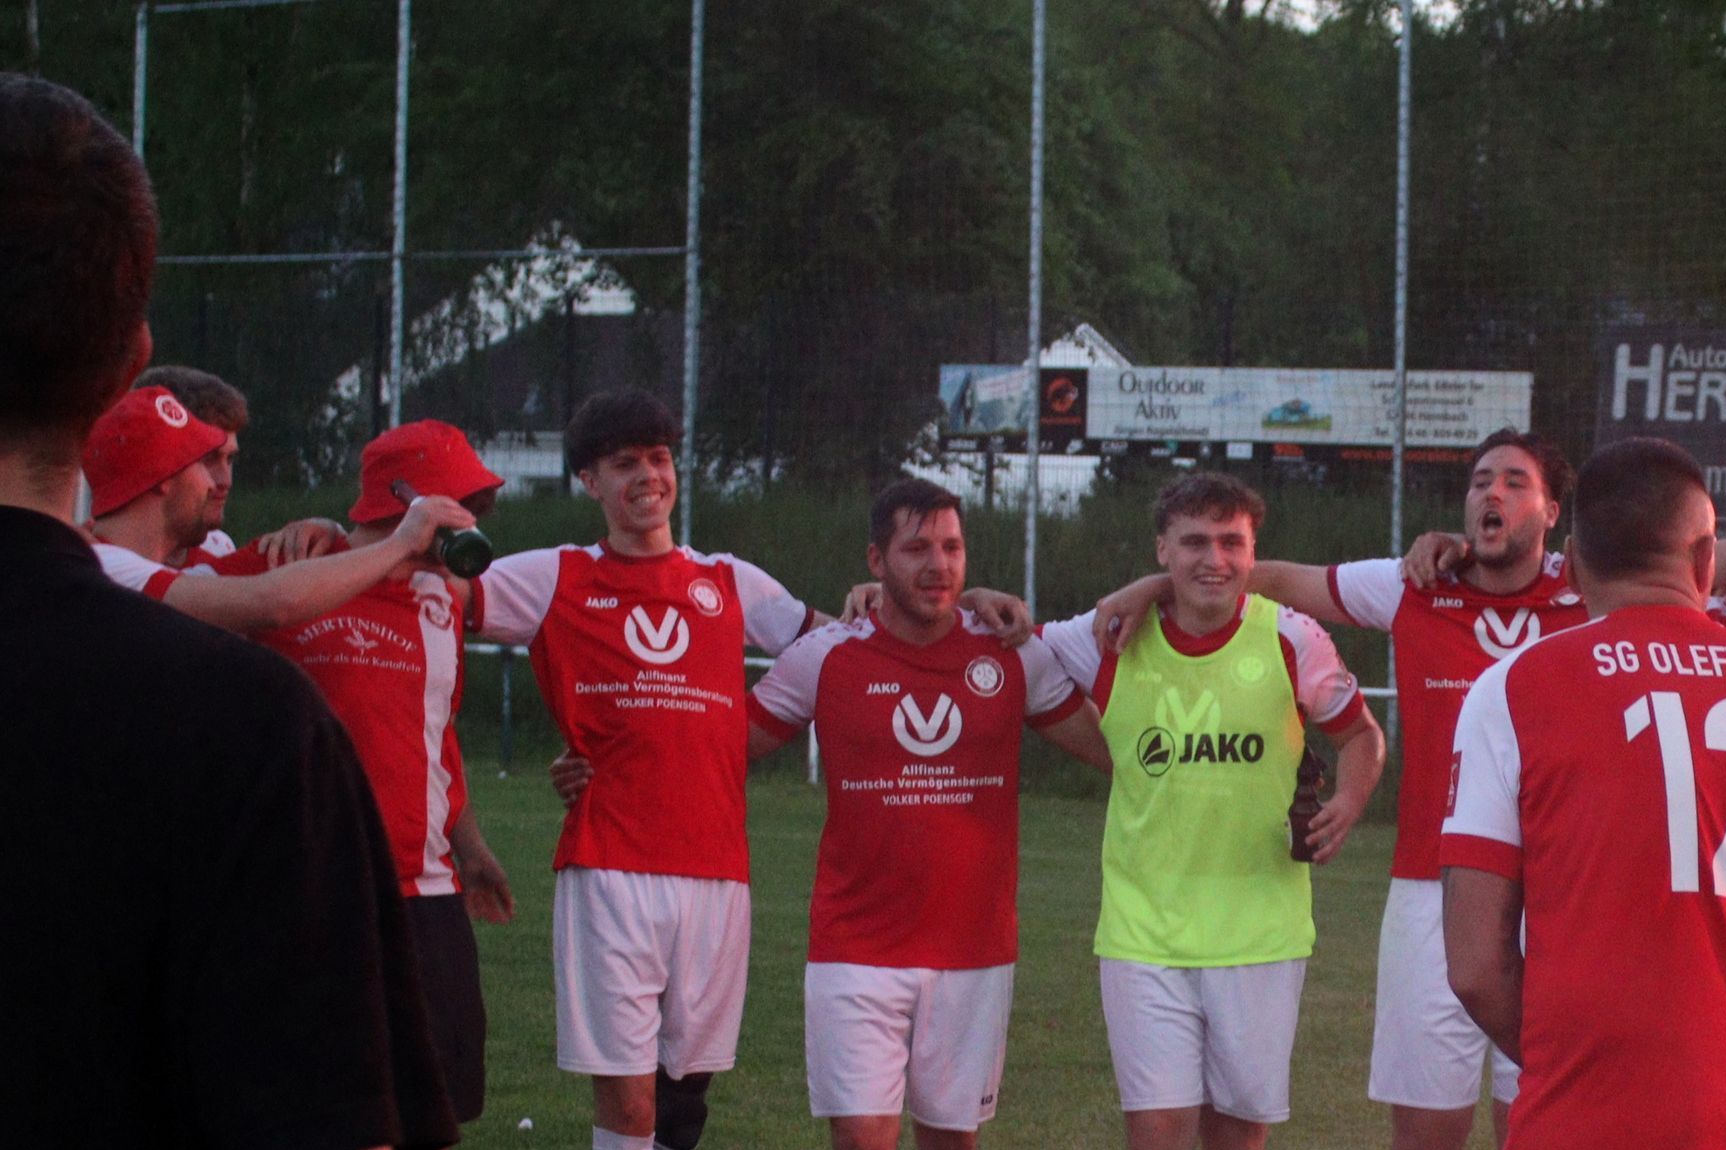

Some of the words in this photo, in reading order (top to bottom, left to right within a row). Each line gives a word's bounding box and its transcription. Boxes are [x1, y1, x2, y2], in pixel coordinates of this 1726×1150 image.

[1118, 370, 1205, 396] Outdoor
[1134, 400, 1182, 421] Aktiv
[585, 597, 619, 608] JAKO
[1432, 597, 1464, 608] JAKO
[296, 616, 418, 653] MERTENSHOF
[372, 657, 421, 673] Kartoffeln
[1592, 640, 1640, 677] SG
[636, 670, 687, 683] Allfinanz
[575, 682, 630, 694] Deutsche
[633, 681, 734, 709] Vermögensberatung
[866, 683, 901, 695] JAKO
[615, 697, 655, 709] VOLKER
[656, 697, 707, 713] POENSGEN
[1178, 733, 1265, 764] JAKO
[901, 765, 955, 776] Allfinanz
[842, 779, 894, 791] Deutsche
[896, 775, 1005, 791] Vermögensberatung
[882, 794, 921, 806] VOLKER
[923, 793, 974, 805] POENSGEN
